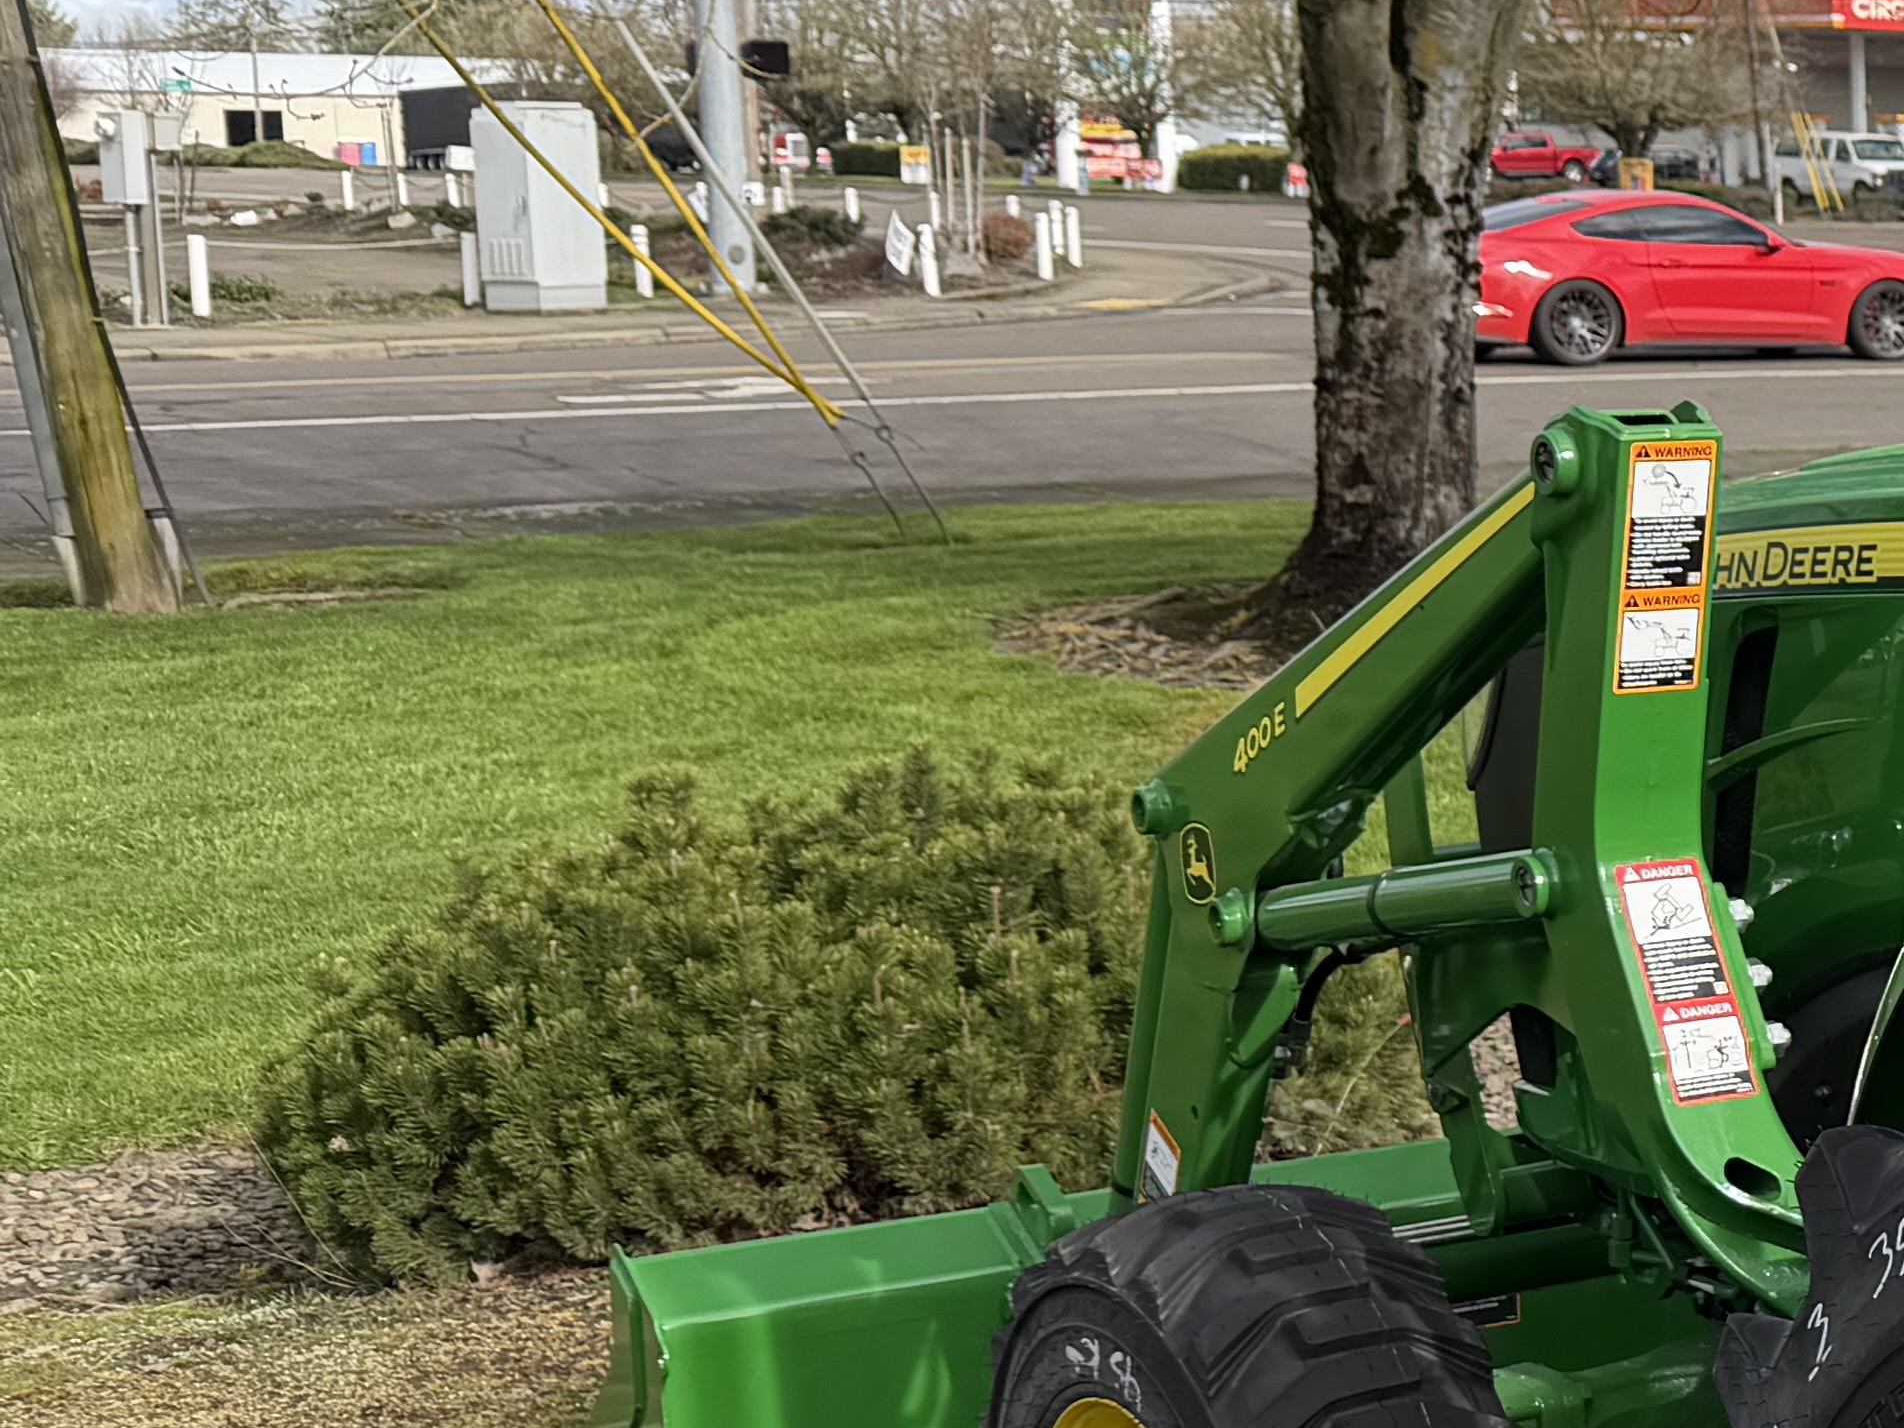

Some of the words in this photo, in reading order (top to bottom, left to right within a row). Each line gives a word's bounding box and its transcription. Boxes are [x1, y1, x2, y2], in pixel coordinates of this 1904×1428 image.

[1654, 446, 1712, 458] WARNING
[1764, 541, 1878, 583] DEERE
[1643, 593, 1701, 607] WARNING
[1640, 864, 1694, 880] DANGER
[1679, 1002, 1733, 1020] DANGER
